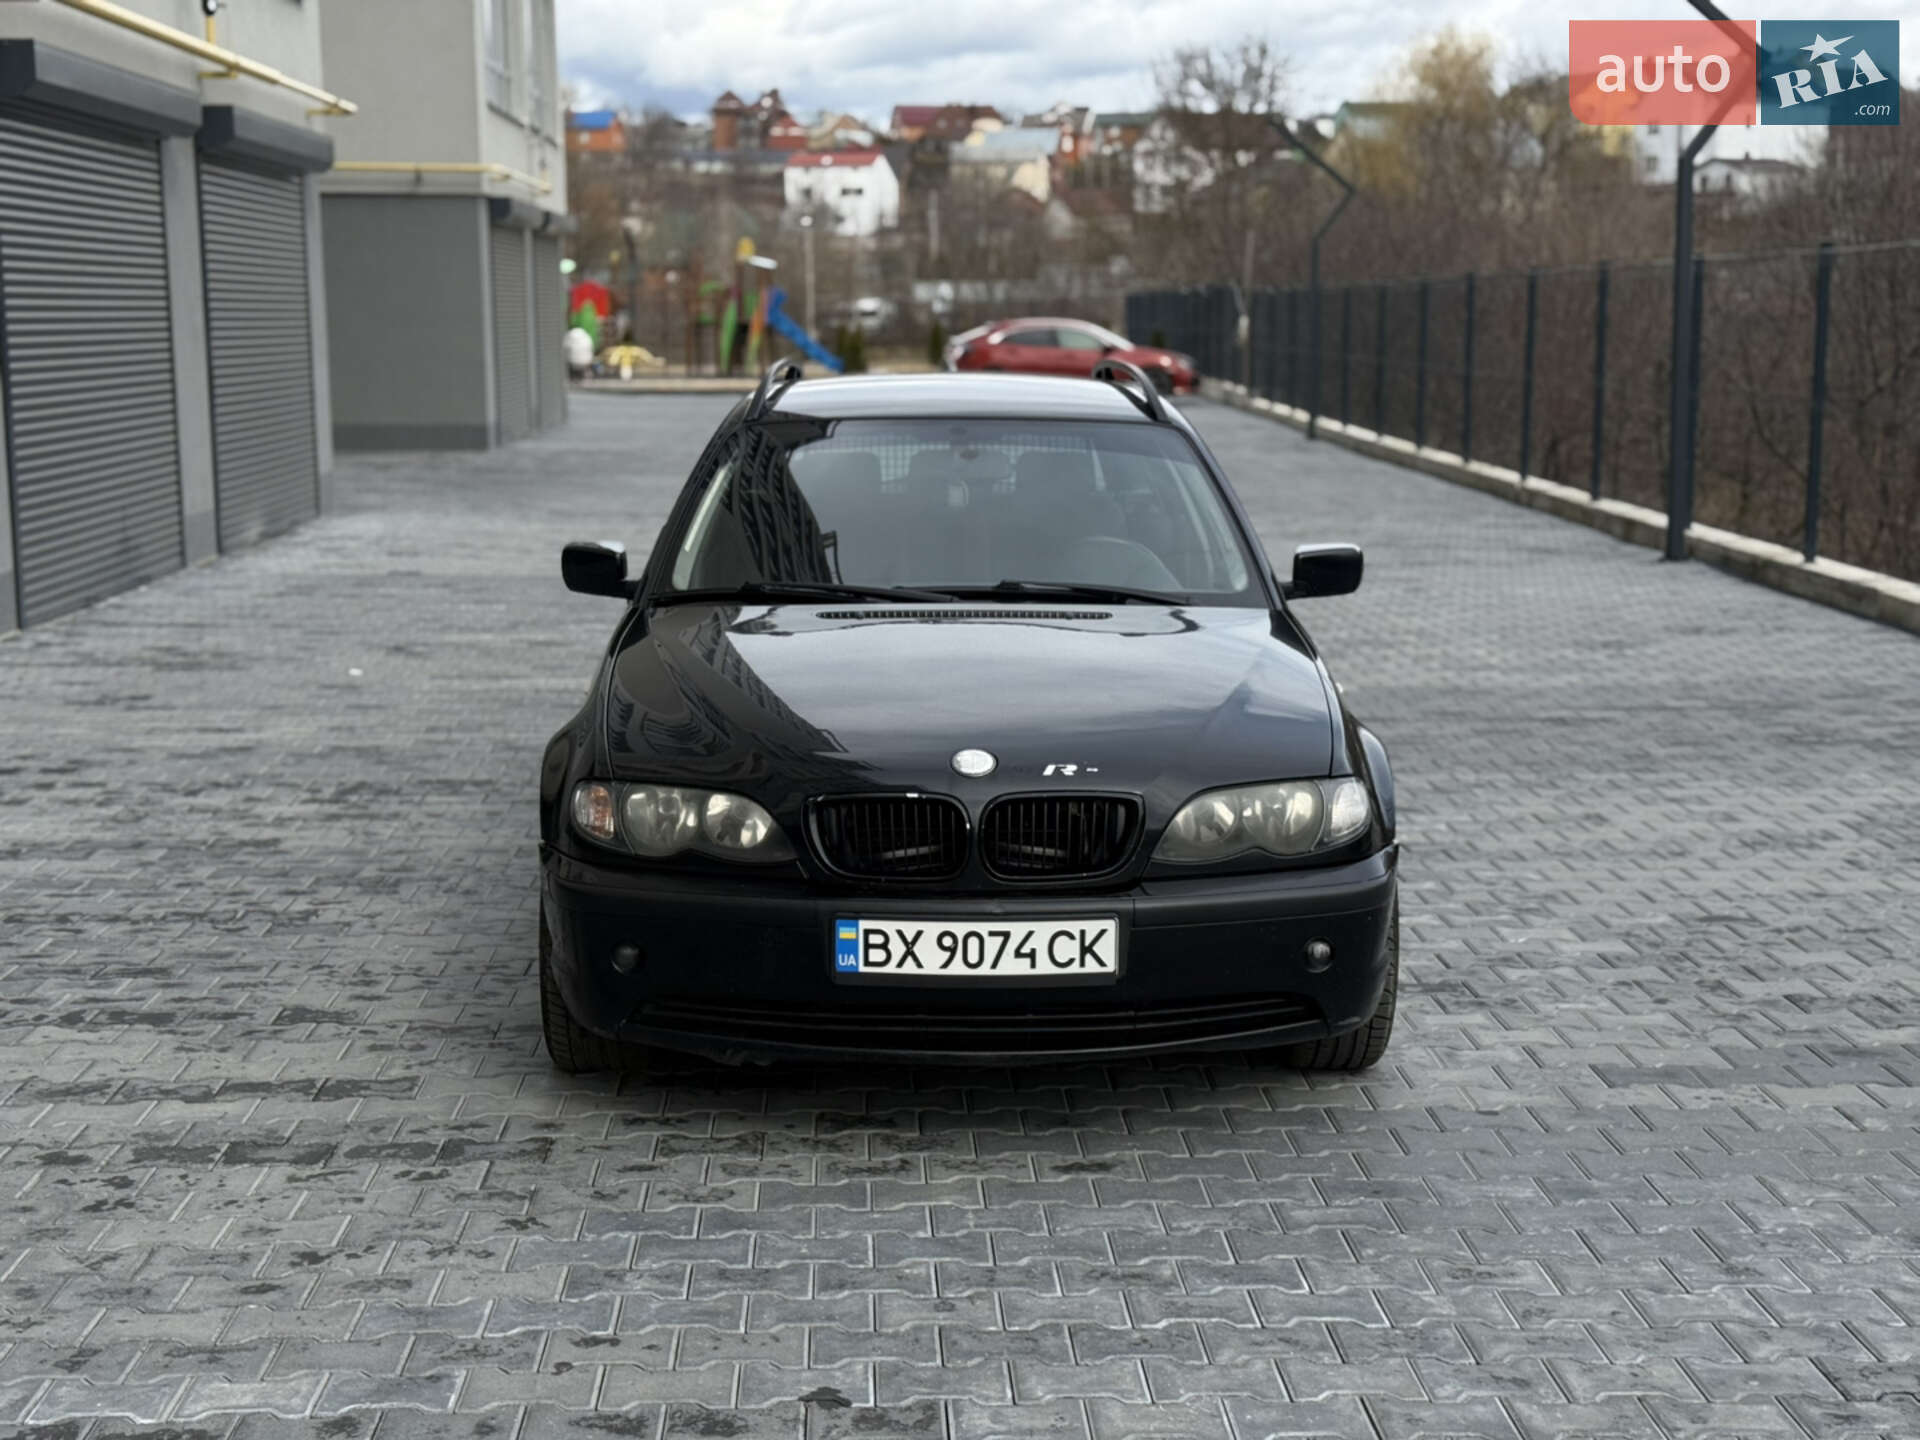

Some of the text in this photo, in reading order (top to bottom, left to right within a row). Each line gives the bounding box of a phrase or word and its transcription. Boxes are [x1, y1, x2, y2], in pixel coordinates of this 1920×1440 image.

[838, 955, 856, 966] UA
[863, 928, 1109, 970] BX 9074 CK
